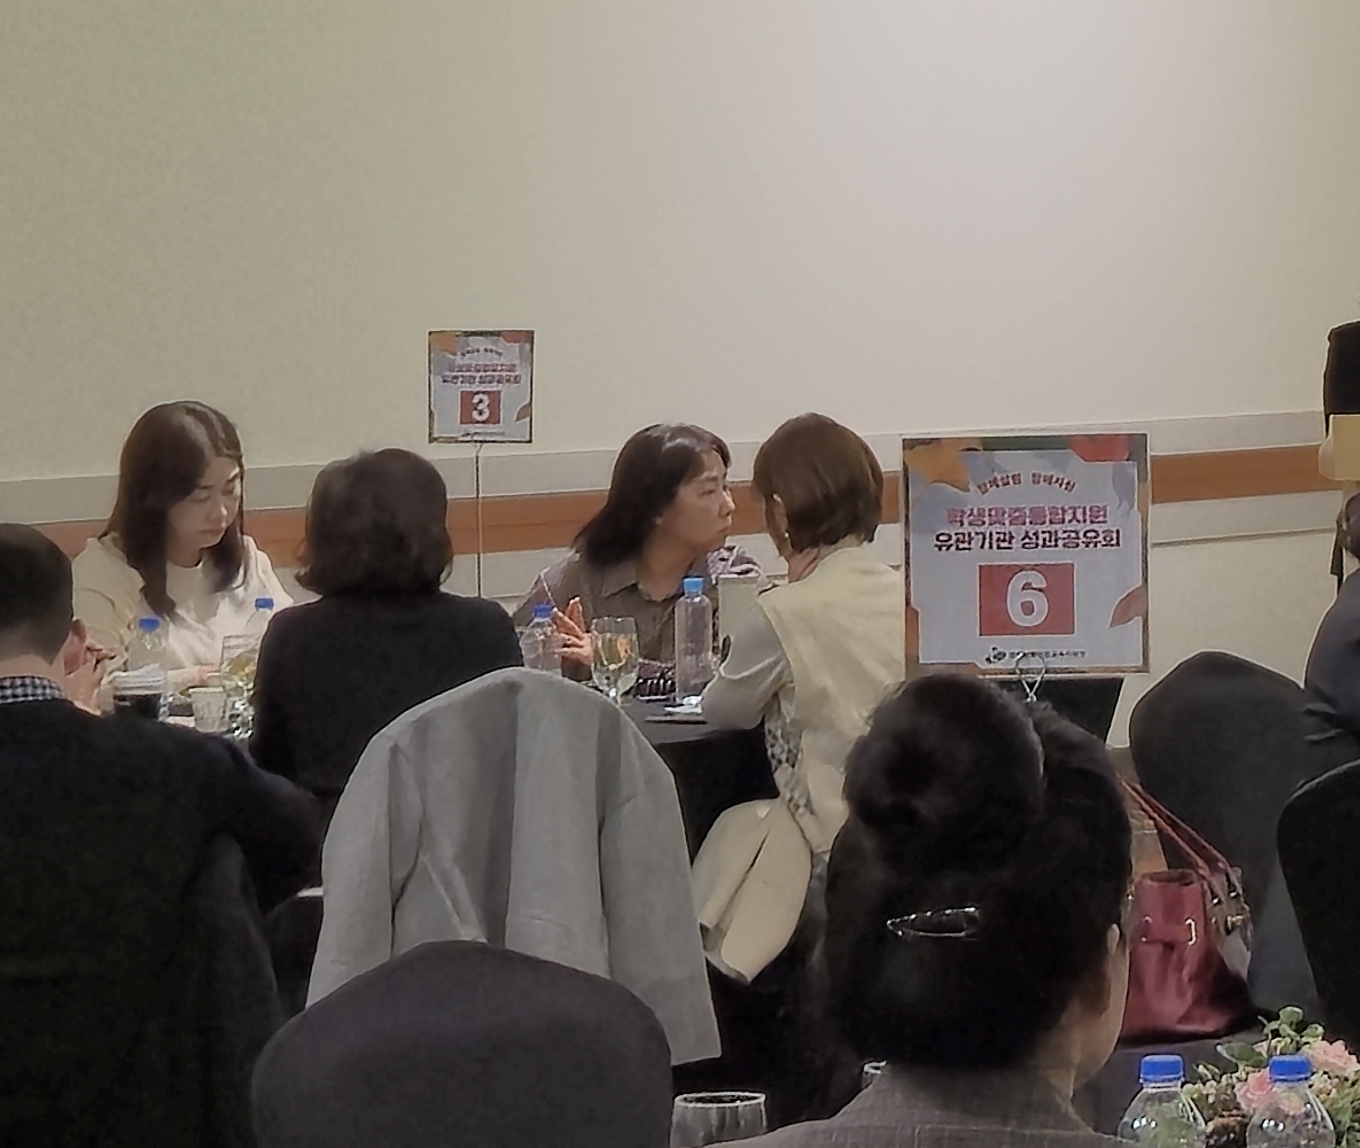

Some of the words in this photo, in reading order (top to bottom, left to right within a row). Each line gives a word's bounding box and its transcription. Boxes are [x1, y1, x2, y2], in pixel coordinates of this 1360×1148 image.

[472, 393, 490, 421] 3
[934, 531, 1016, 552] 유관기관
[1020, 528, 1121, 550] 성과공유회
[1006, 569, 1048, 627] 6
